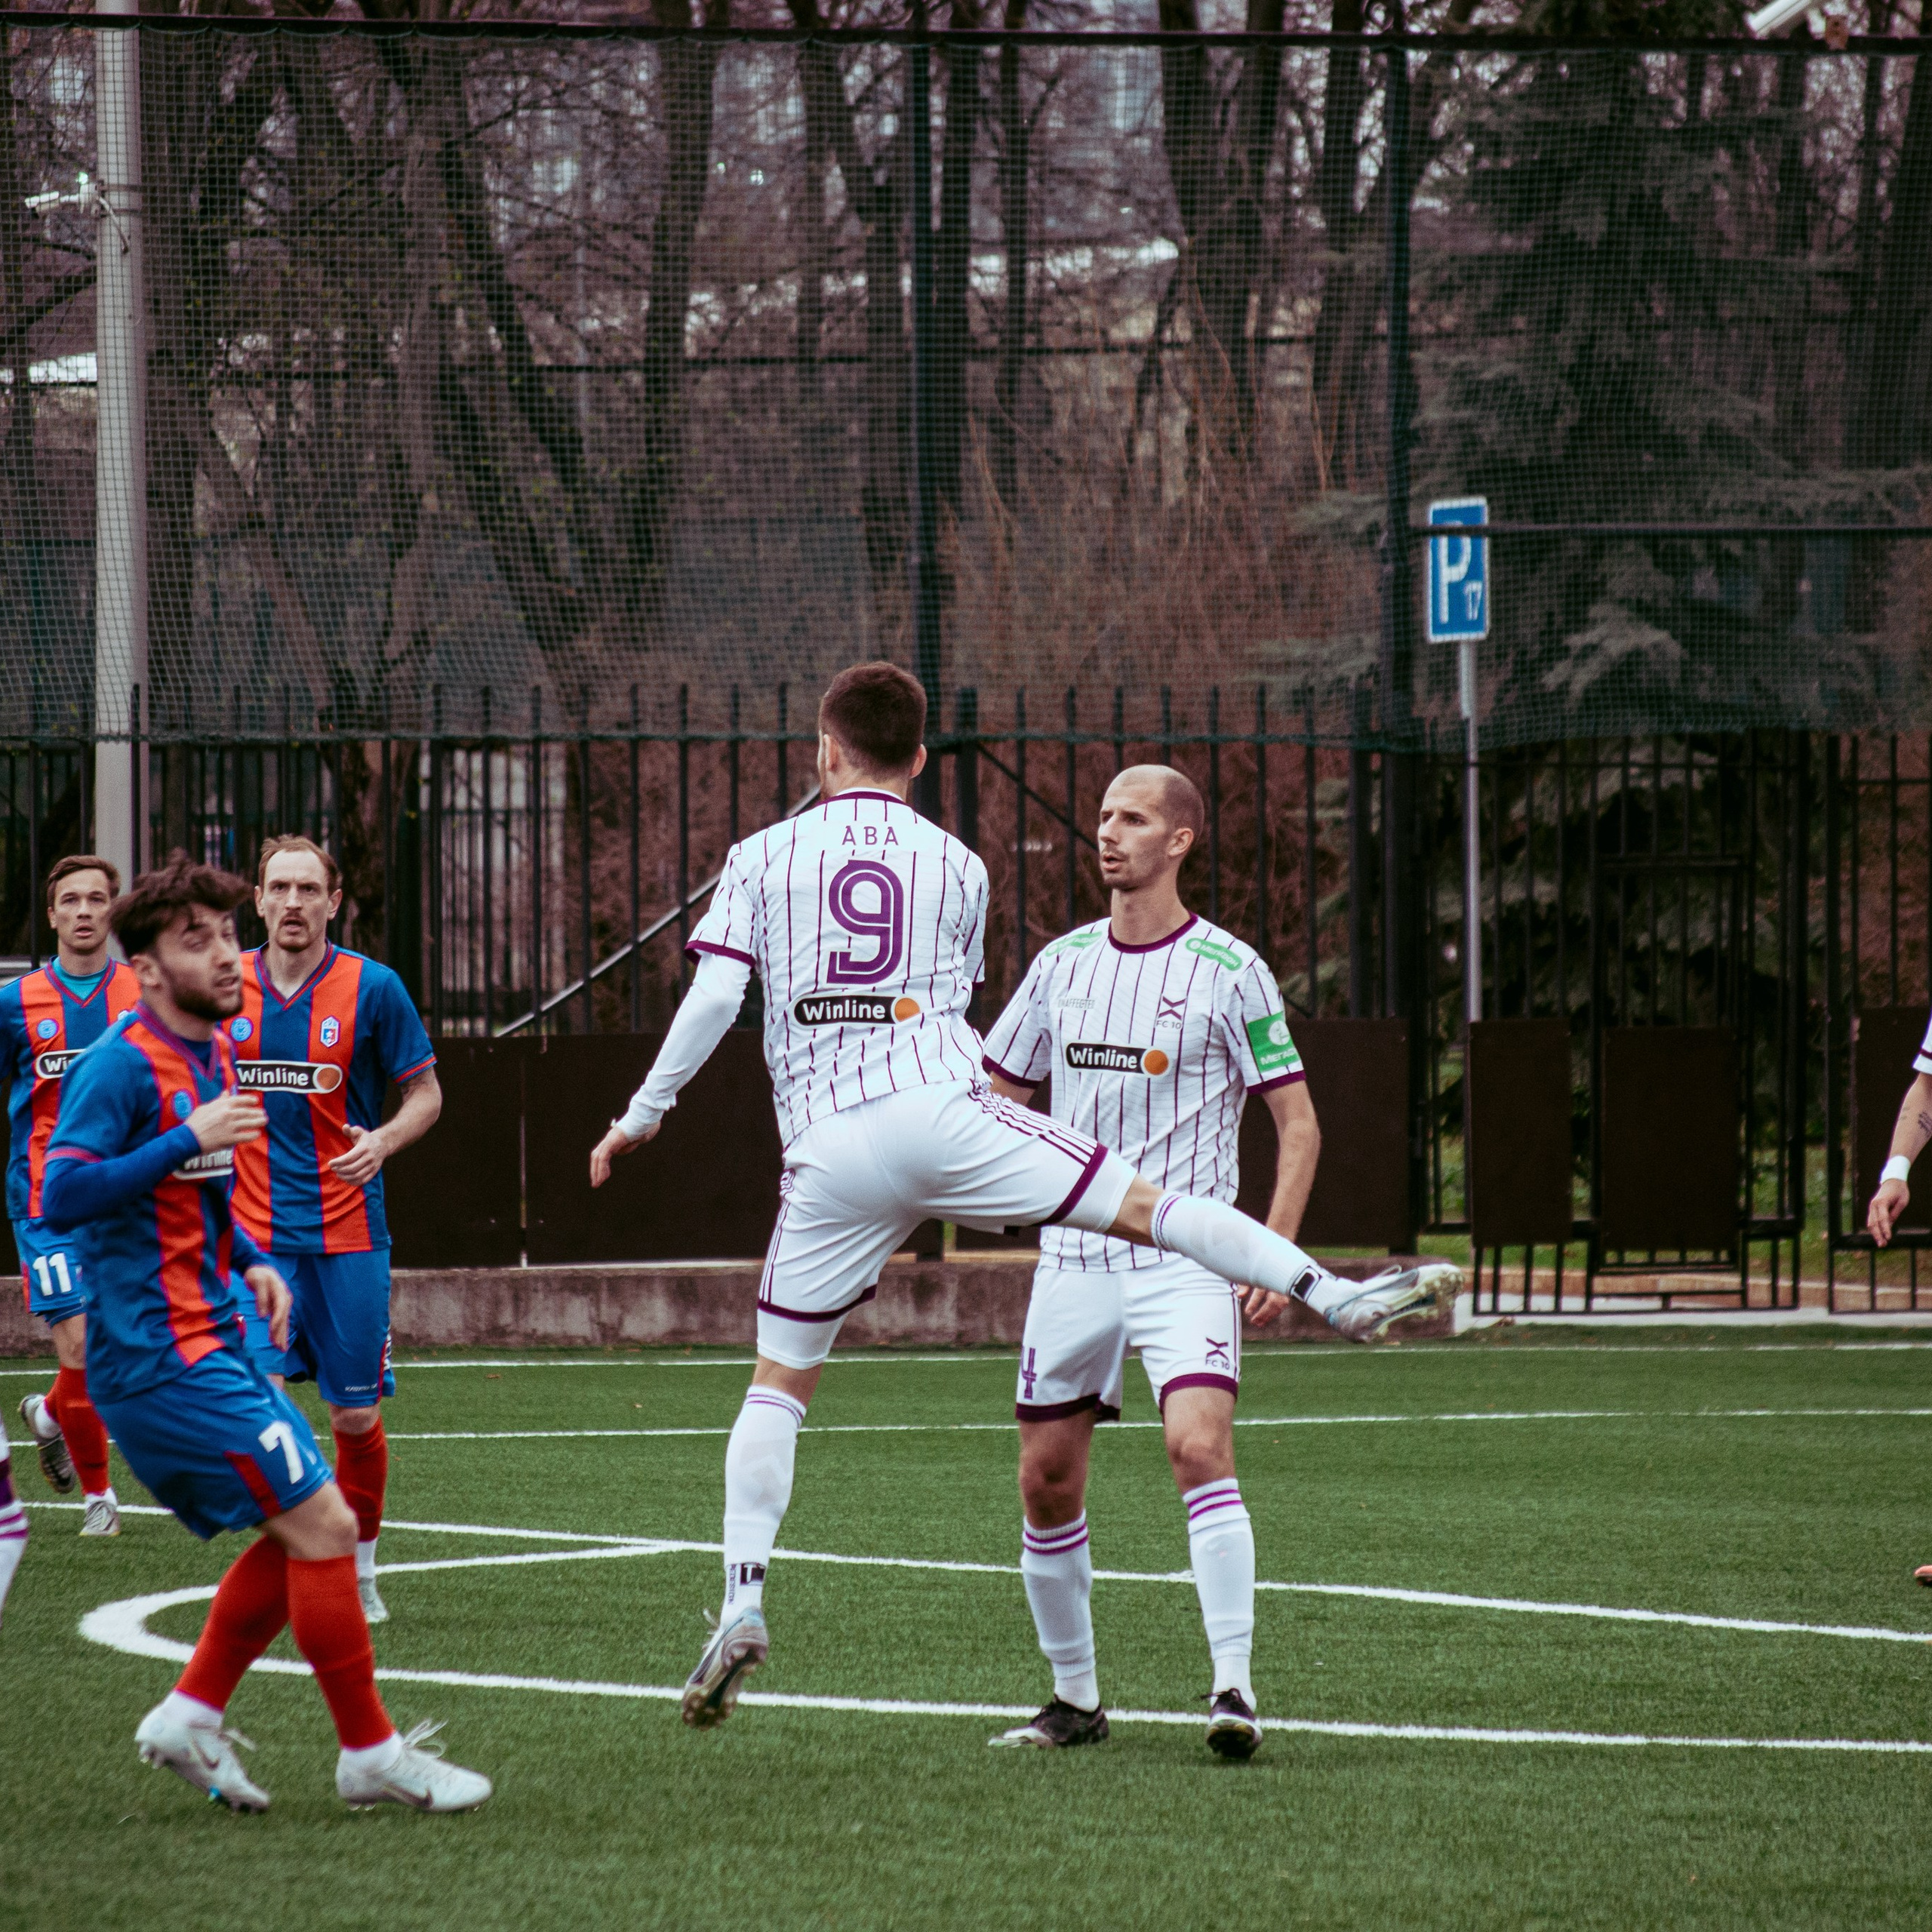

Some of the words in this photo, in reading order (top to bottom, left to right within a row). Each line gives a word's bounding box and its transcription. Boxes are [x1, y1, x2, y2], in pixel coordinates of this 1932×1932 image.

[1438, 521, 1472, 624] P
[841, 825, 899, 846] ABA
[826, 859, 904, 985] 9
[802, 999, 886, 1021] Winline
[1069, 1047, 1138, 1069] Winline
[236, 1067, 309, 1087] Winline
[32, 1253, 72, 1297] 11
[259, 1421, 305, 1484] 7
